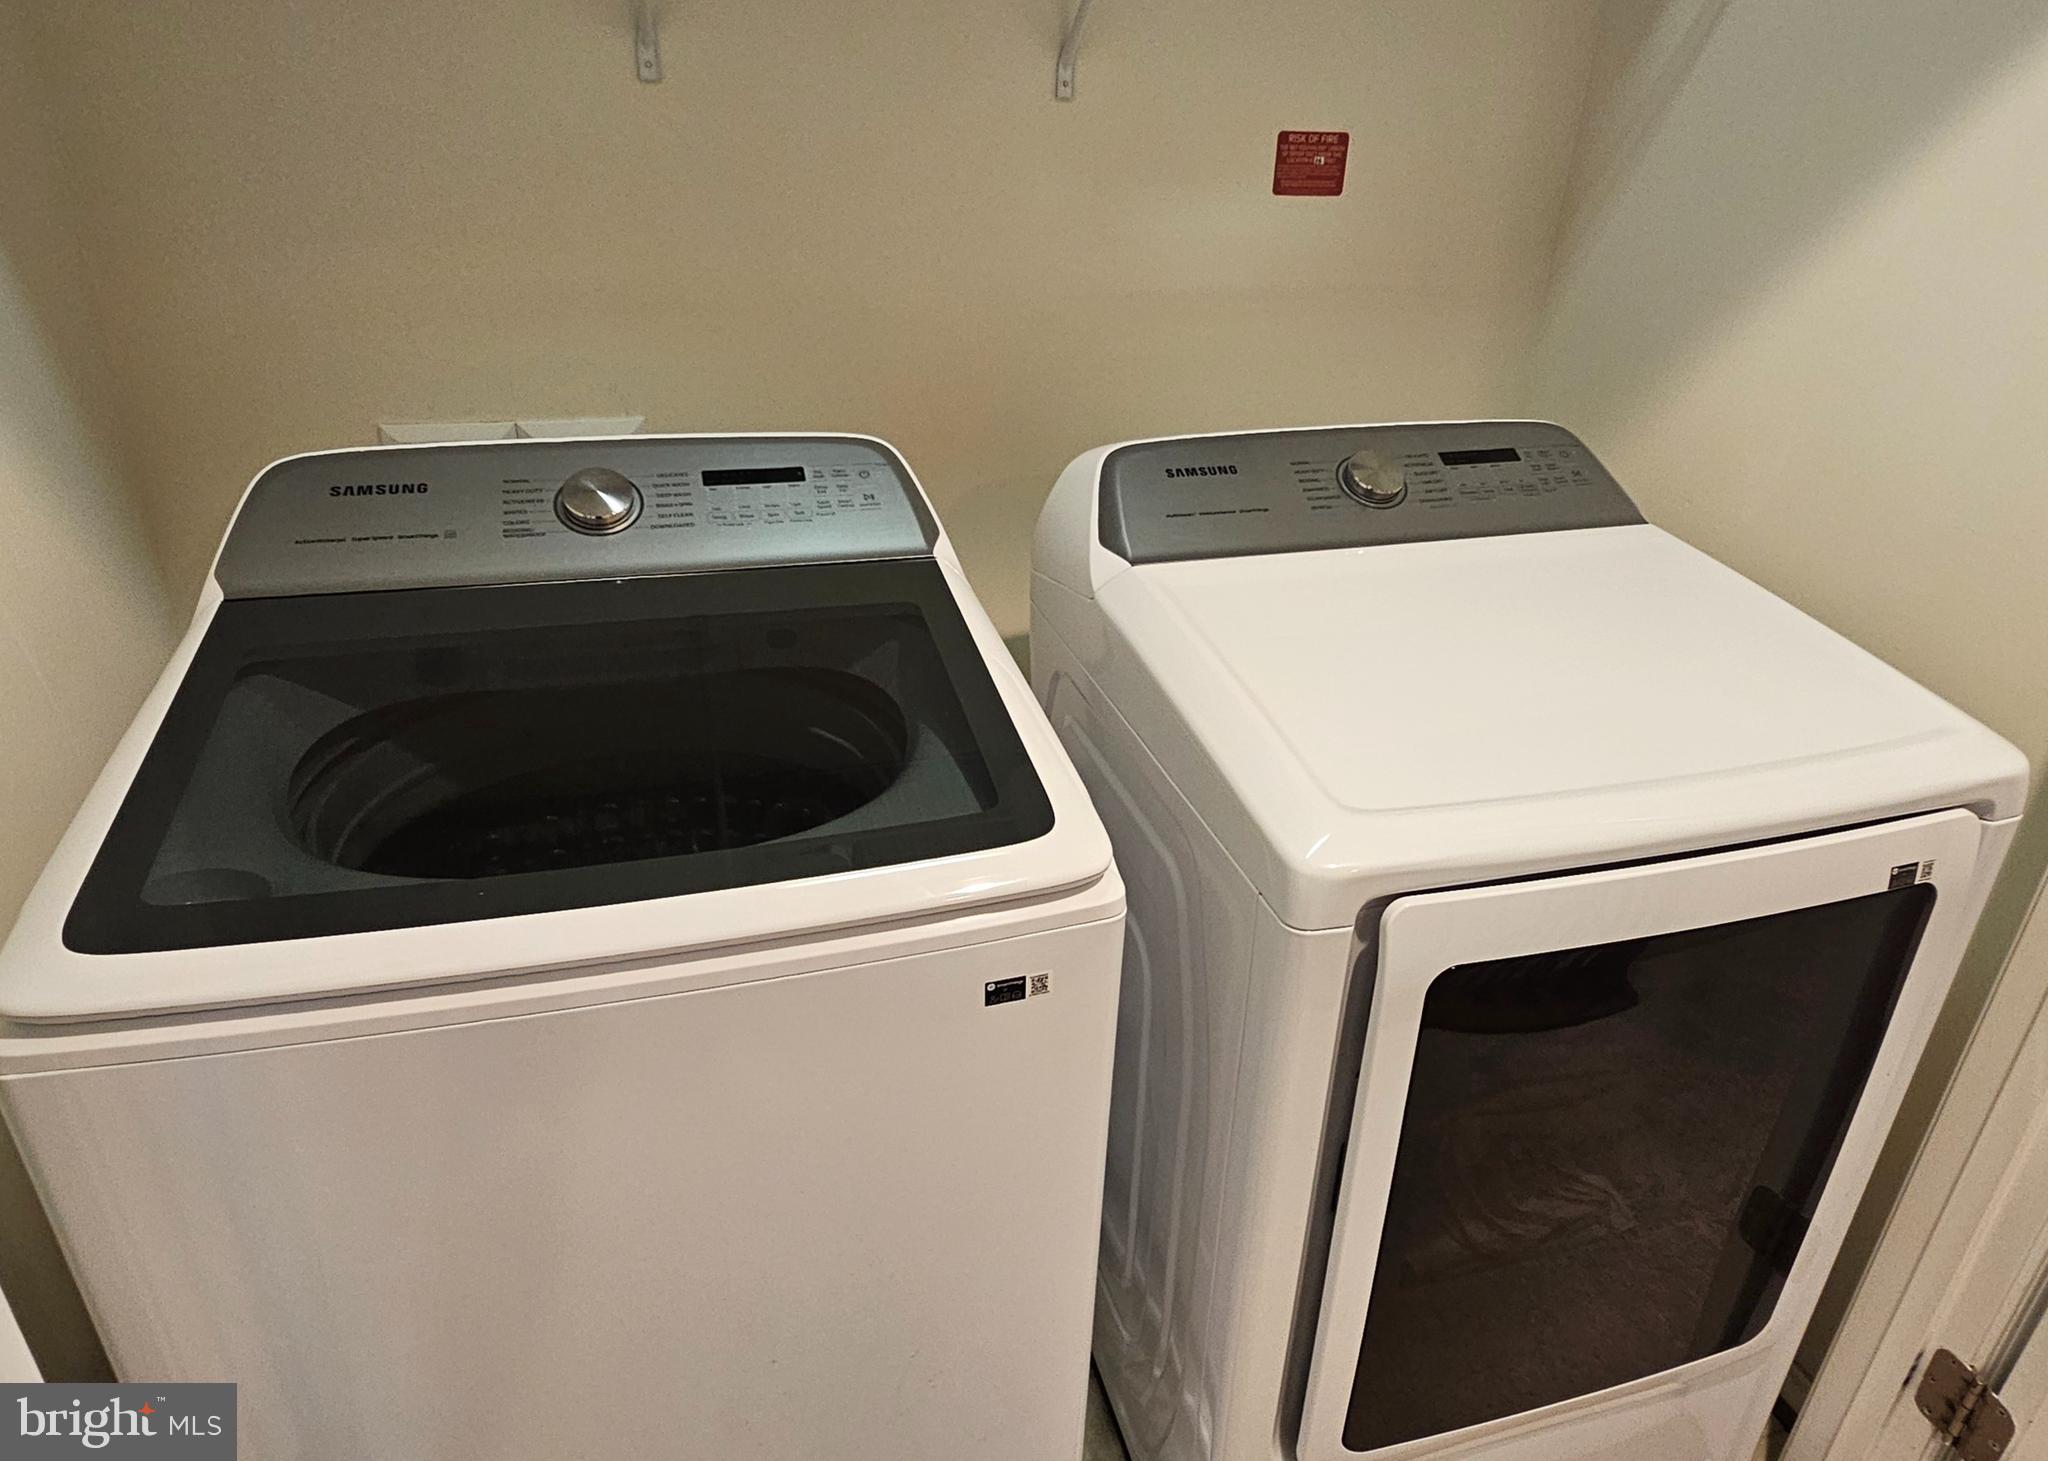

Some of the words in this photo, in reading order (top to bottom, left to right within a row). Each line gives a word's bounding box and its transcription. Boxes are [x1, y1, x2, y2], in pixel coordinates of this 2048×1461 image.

[1288, 133, 1307, 143] RISK
[1308, 134, 1320, 144] OF
[1321, 134, 1340, 144] FIRE
[1165, 464, 1238, 478] SAMSUNG
[329, 483, 429, 497] SAMSUNG
